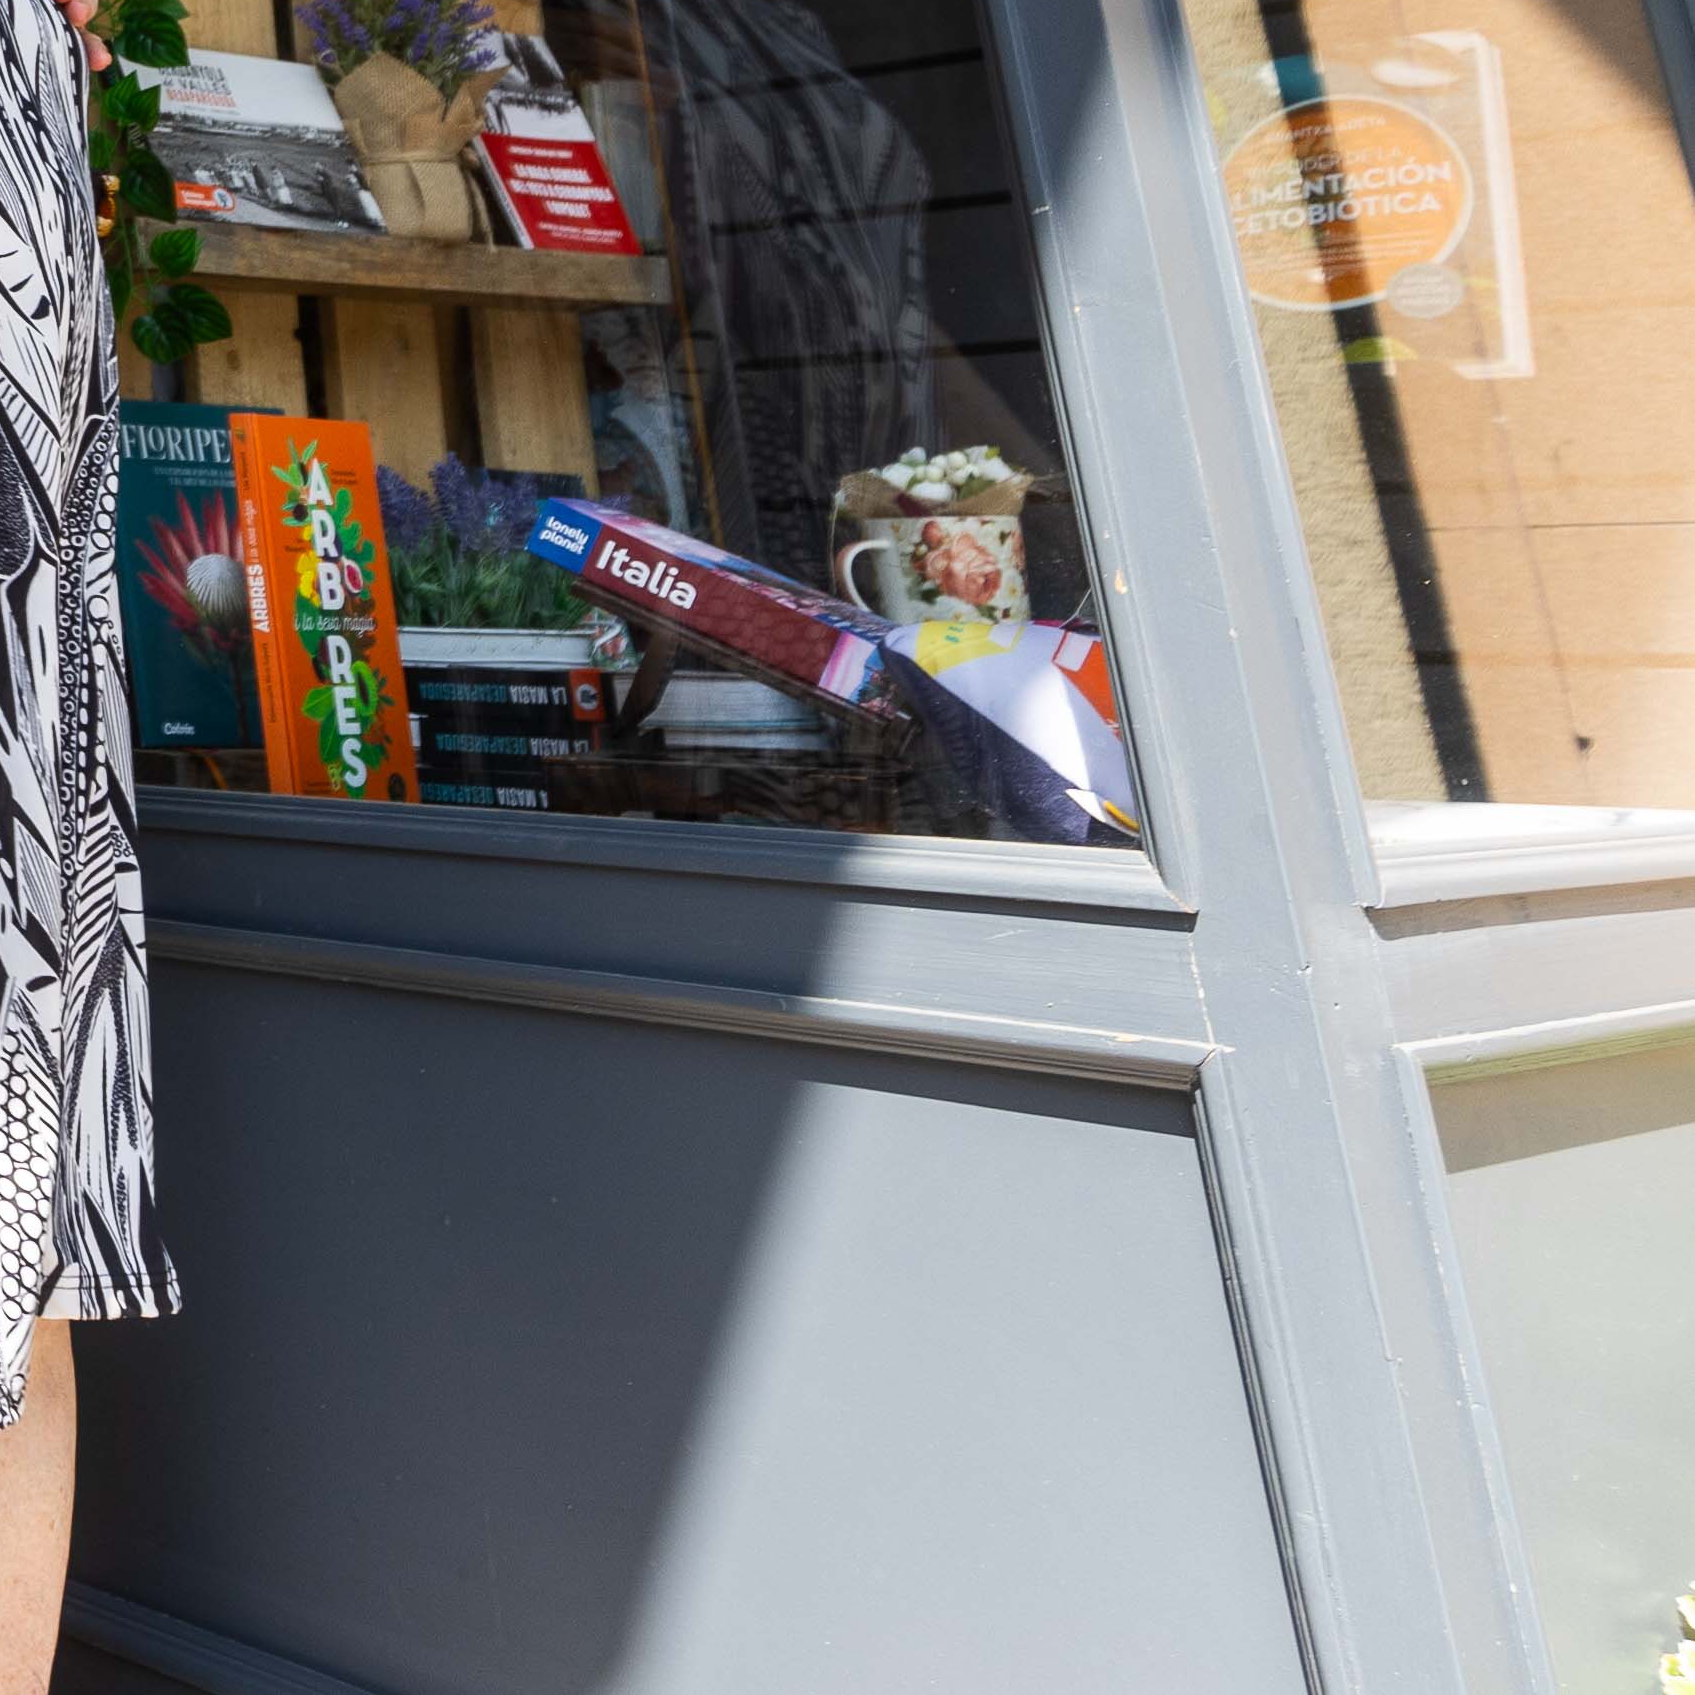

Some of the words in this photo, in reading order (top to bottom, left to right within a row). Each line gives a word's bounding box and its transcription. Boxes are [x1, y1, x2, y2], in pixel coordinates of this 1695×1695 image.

[1233, 158, 1453, 211] LIMENTACIÓN
[120, 424, 233, 464] FLORIPE
[539, 529, 586, 556] planet
[546, 515, 590, 545] lonely
[595, 540, 698, 610] Italia
[245, 564, 271, 634] ARBRES
[302, 615, 316, 631] la
[551, 686, 568, 706] LA
